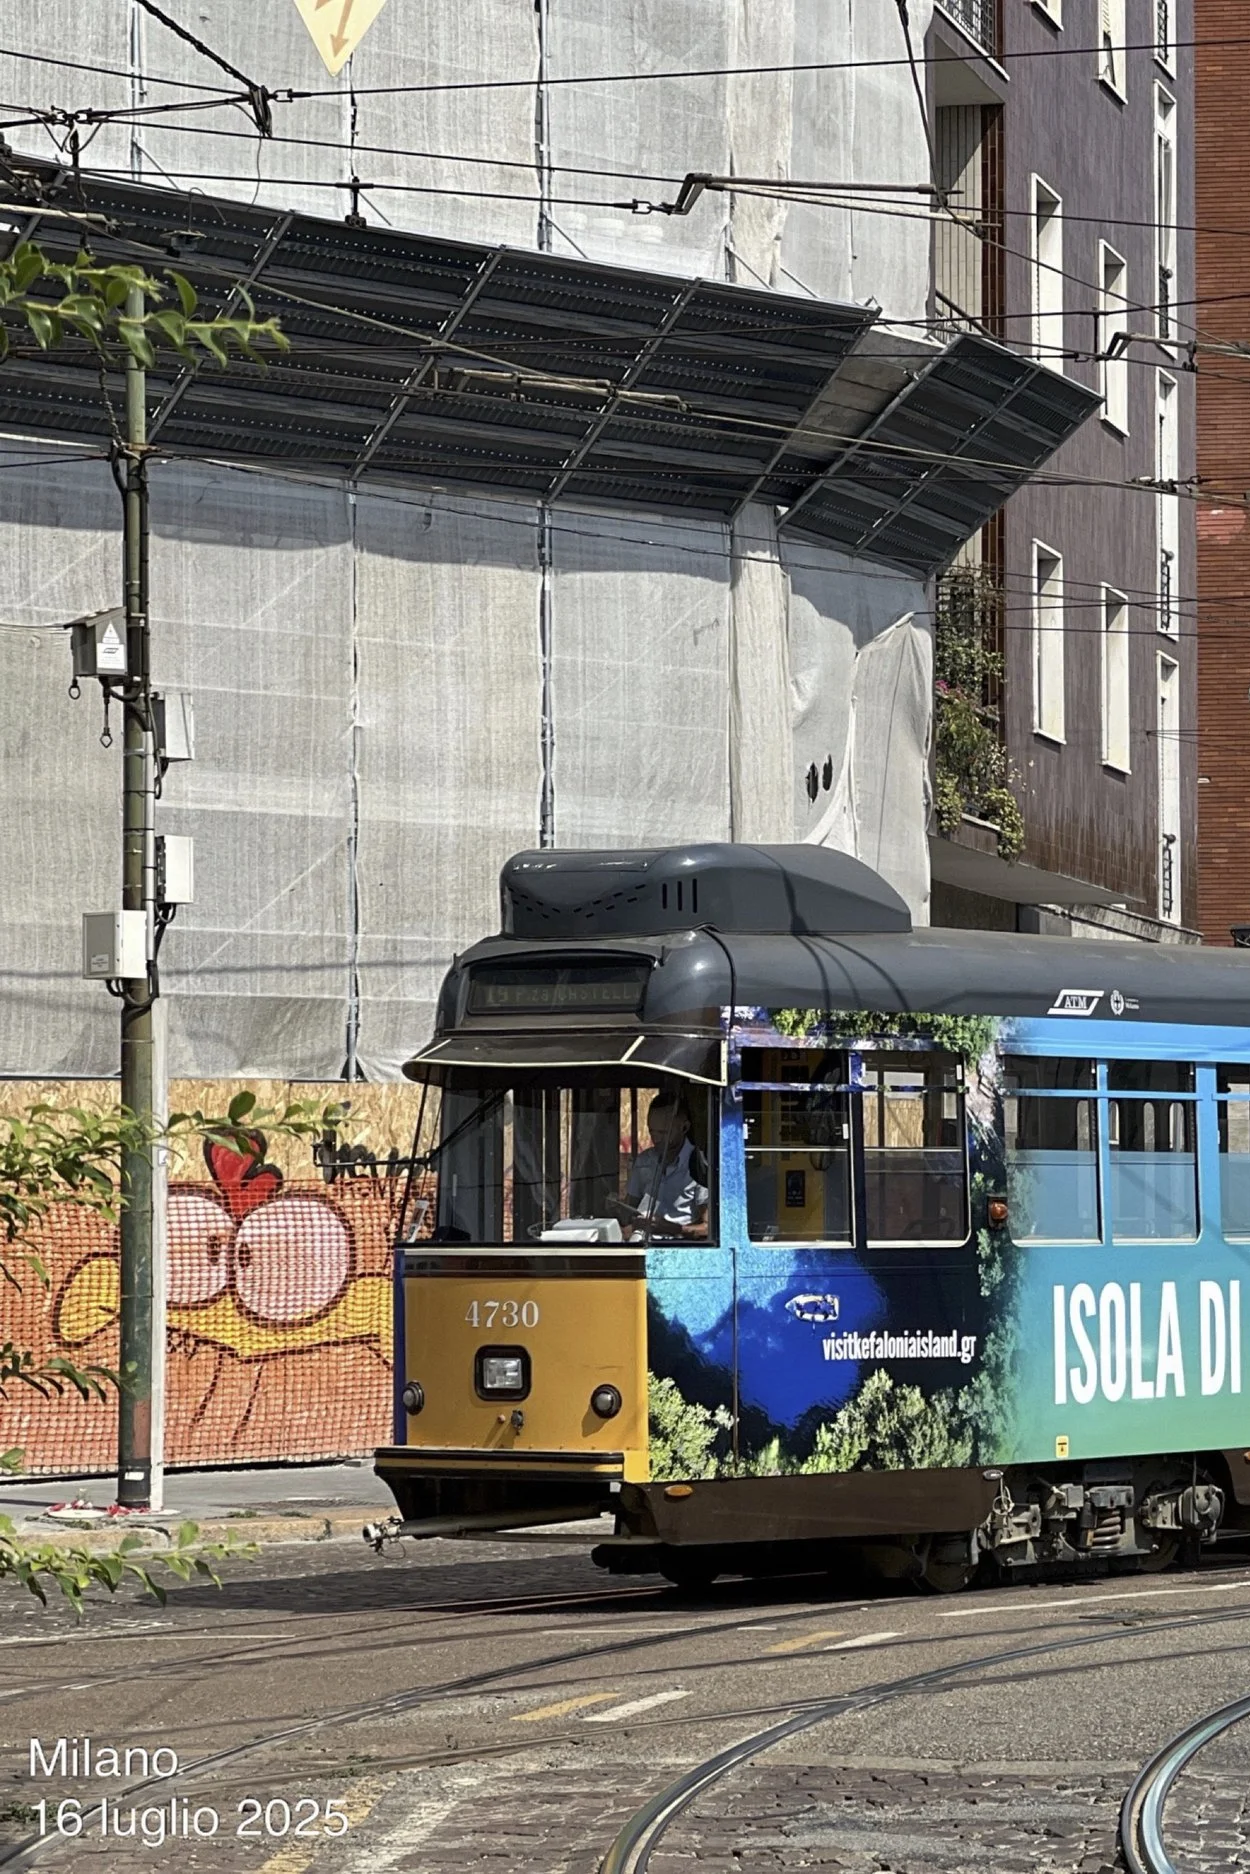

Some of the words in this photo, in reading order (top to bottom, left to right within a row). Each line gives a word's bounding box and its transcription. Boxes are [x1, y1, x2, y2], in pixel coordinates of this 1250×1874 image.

[465, 1300, 539, 1328] 4730
[822, 1329, 977, 1364] visitkefaloniaisland.gr
[1053, 1280, 1186, 1406] ISOLA
[1200, 1279, 1242, 1396] DI
